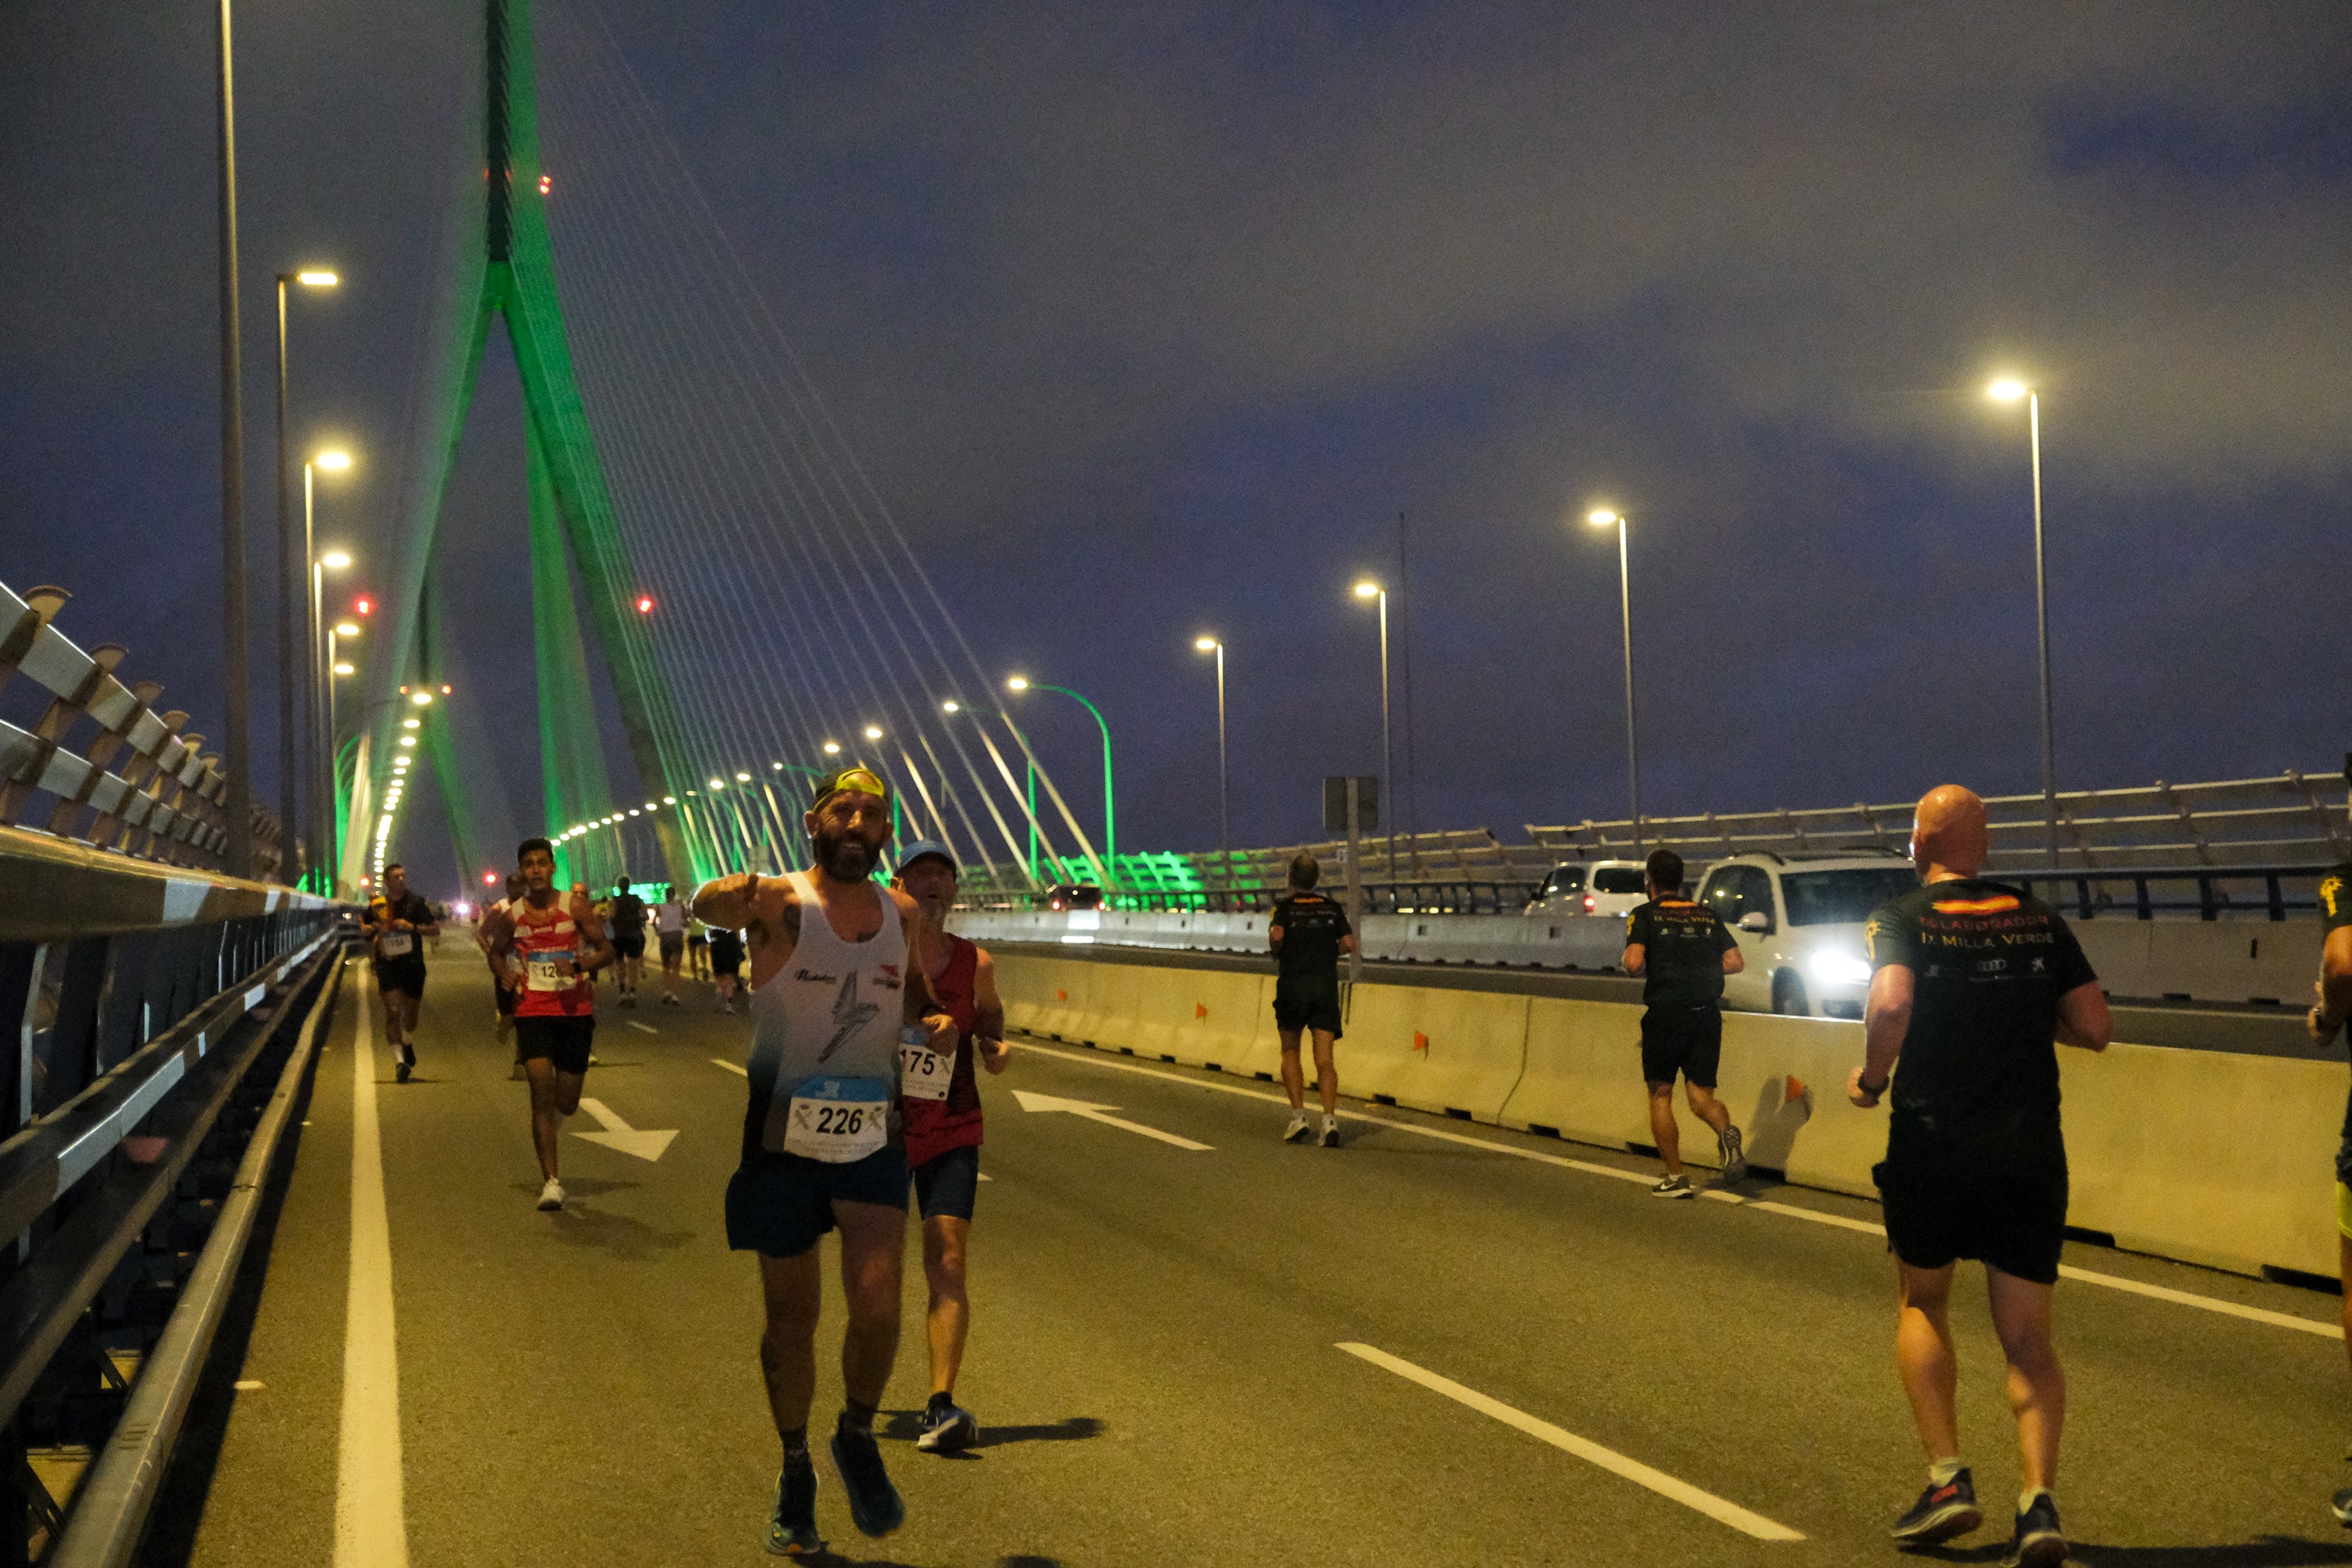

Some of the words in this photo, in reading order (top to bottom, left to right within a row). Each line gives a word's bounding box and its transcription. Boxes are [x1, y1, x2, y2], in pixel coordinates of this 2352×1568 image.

[2001, 932, 2054, 946] VERDE
[541, 966, 561, 978] 12
[816, 1107, 864, 1135] 226
